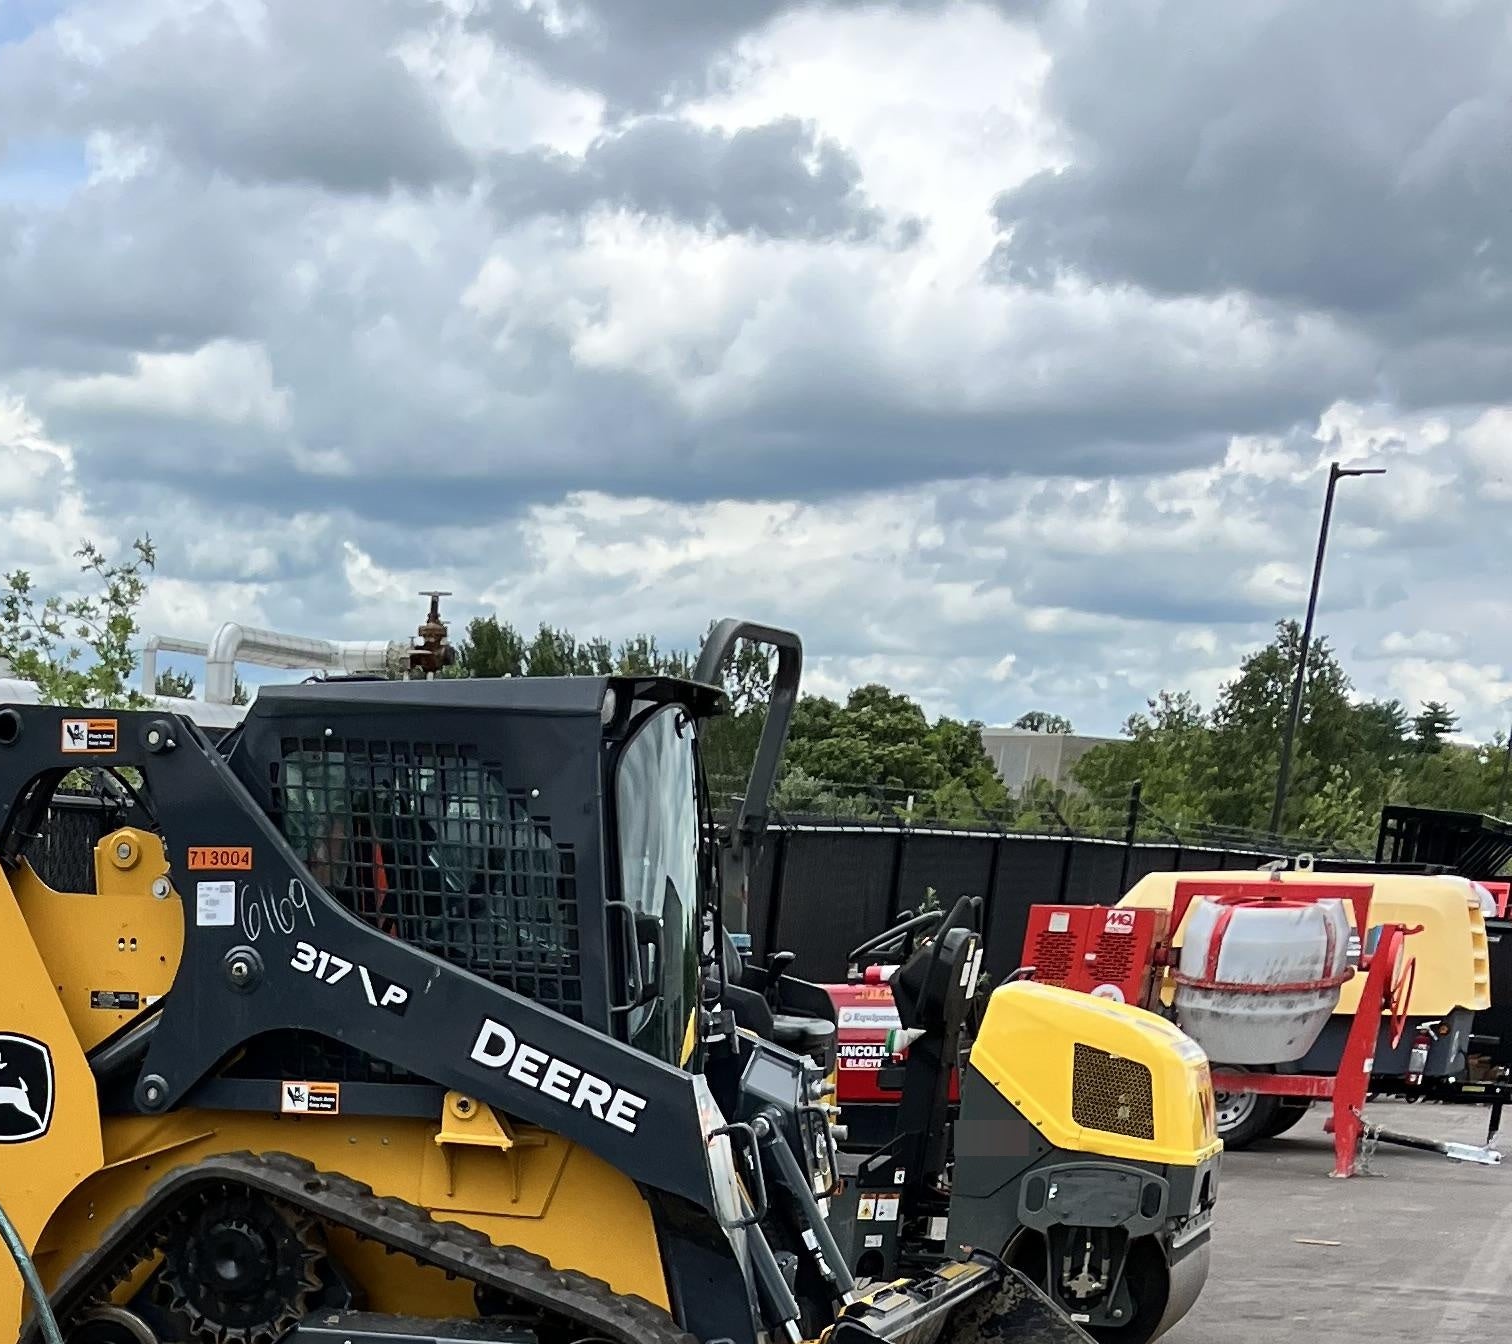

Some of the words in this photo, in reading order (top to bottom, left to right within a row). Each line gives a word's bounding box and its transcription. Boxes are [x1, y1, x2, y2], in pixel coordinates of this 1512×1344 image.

[189, 850, 249, 866] 713004
[240, 878, 316, 941] 6169
[290, 941, 354, 985] 317
[470, 1018, 647, 1133] DEERE
